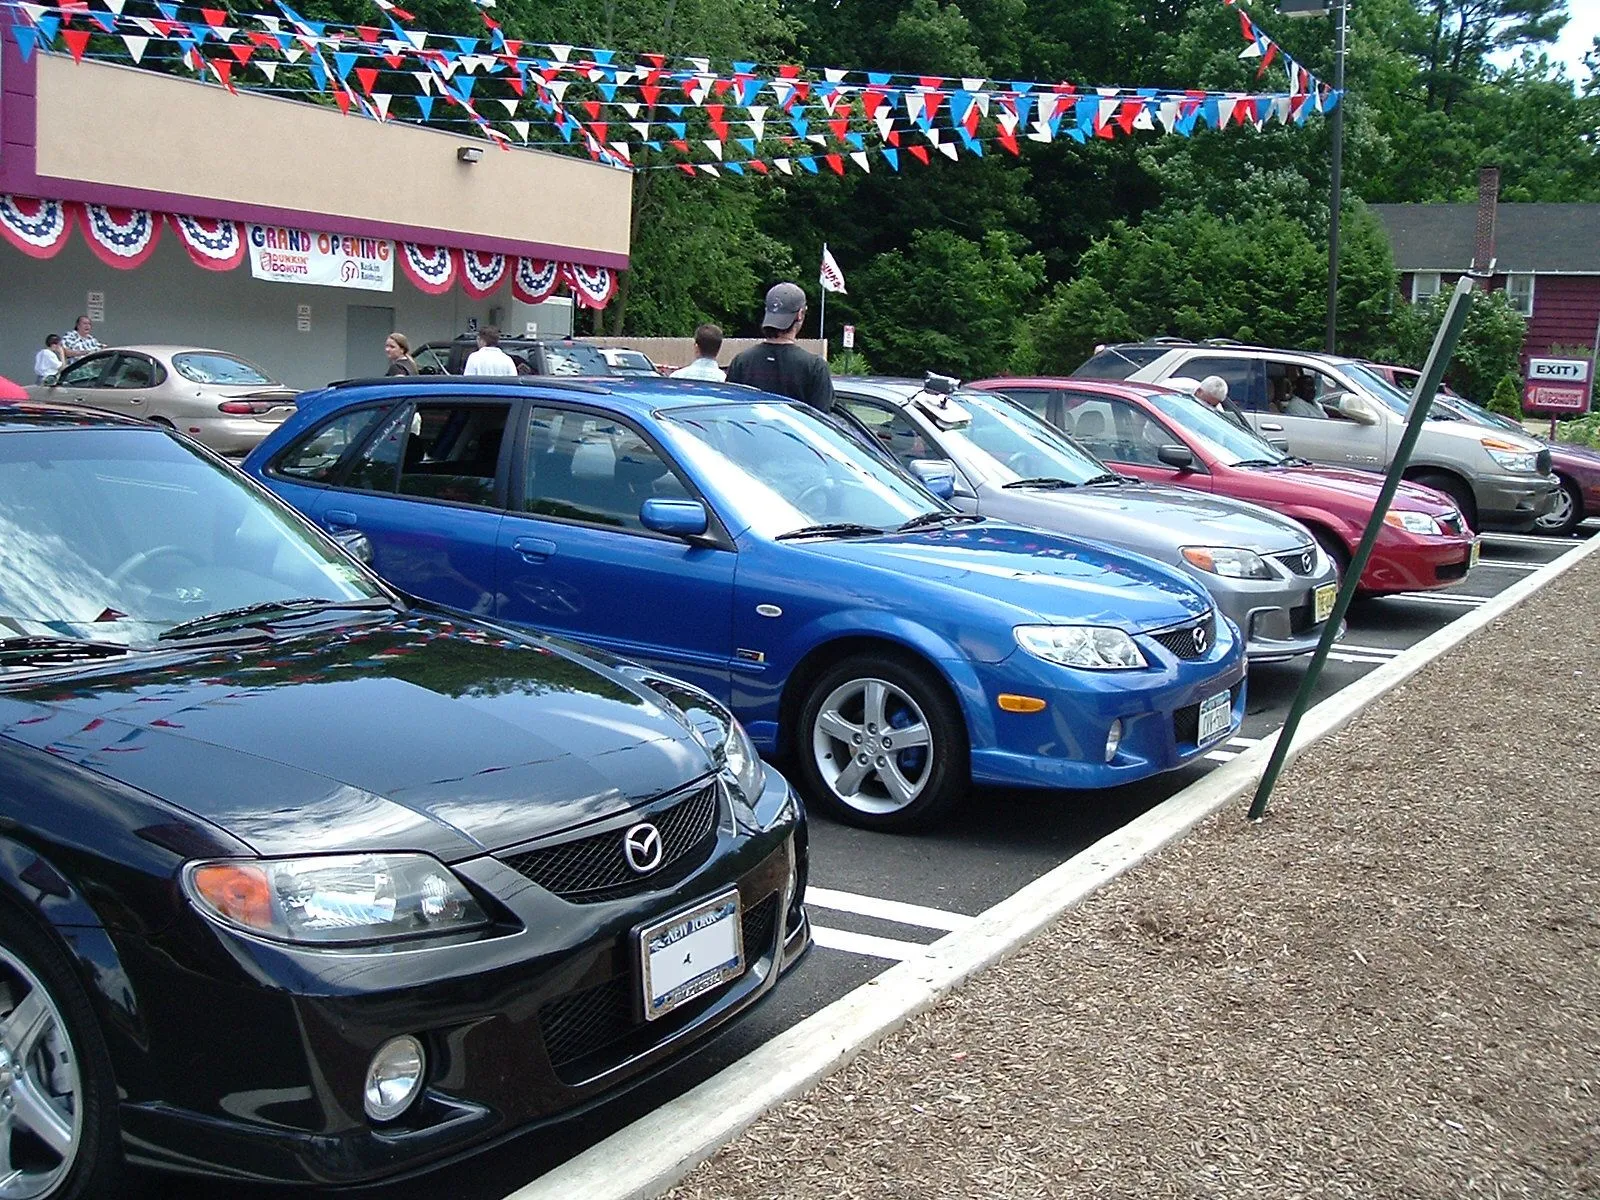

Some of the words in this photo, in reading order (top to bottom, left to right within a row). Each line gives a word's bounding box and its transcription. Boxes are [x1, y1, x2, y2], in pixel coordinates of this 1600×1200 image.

[252, 226, 311, 252] GRAND
[317, 233, 389, 261] OPENING
[272, 263, 309, 275] DONUTS
[1536, 364, 1571, 375] EXIT
